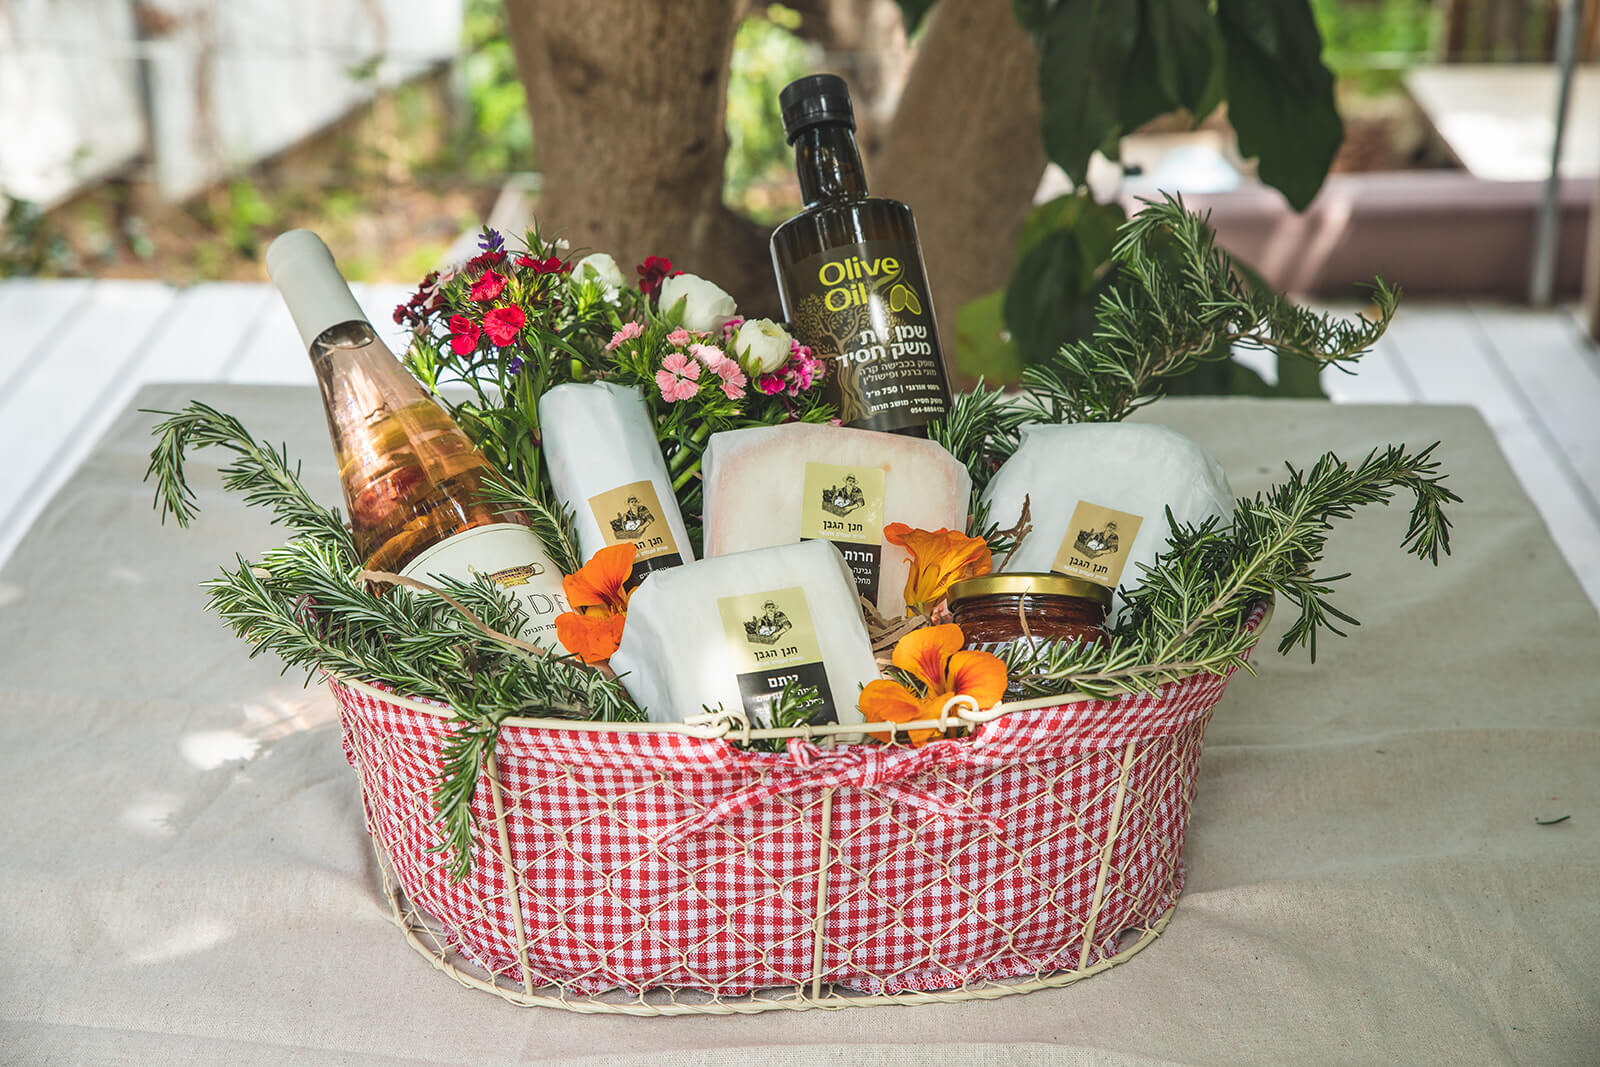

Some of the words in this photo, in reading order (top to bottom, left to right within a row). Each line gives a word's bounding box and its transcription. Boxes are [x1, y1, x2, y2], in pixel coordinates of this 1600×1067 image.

[819, 255, 900, 287] Olive
[824, 282, 868, 312] Oil
[895, 325, 927, 342] שמן
[835, 345, 886, 368] חסיד
[890, 342, 932, 360] משק
[859, 364, 879, 376] קרה
[881, 361, 915, 371] בכבישה
[881, 386, 898, 395] 750
[889, 400, 909, 408] מושב
[823, 520, 844, 530] הגבן
[847, 523, 863, 532] חנן
[648, 536, 664, 547] חנן
[844, 550, 874, 562] חרות
[1069, 556, 1090, 568] הגבן
[853, 567, 872, 575] גבינה
[1092, 563, 1108, 573] חנן
[522, 625, 544, 637] הגולן
[754, 649, 778, 661] הגבן
[780, 646, 798, 657] חנן
